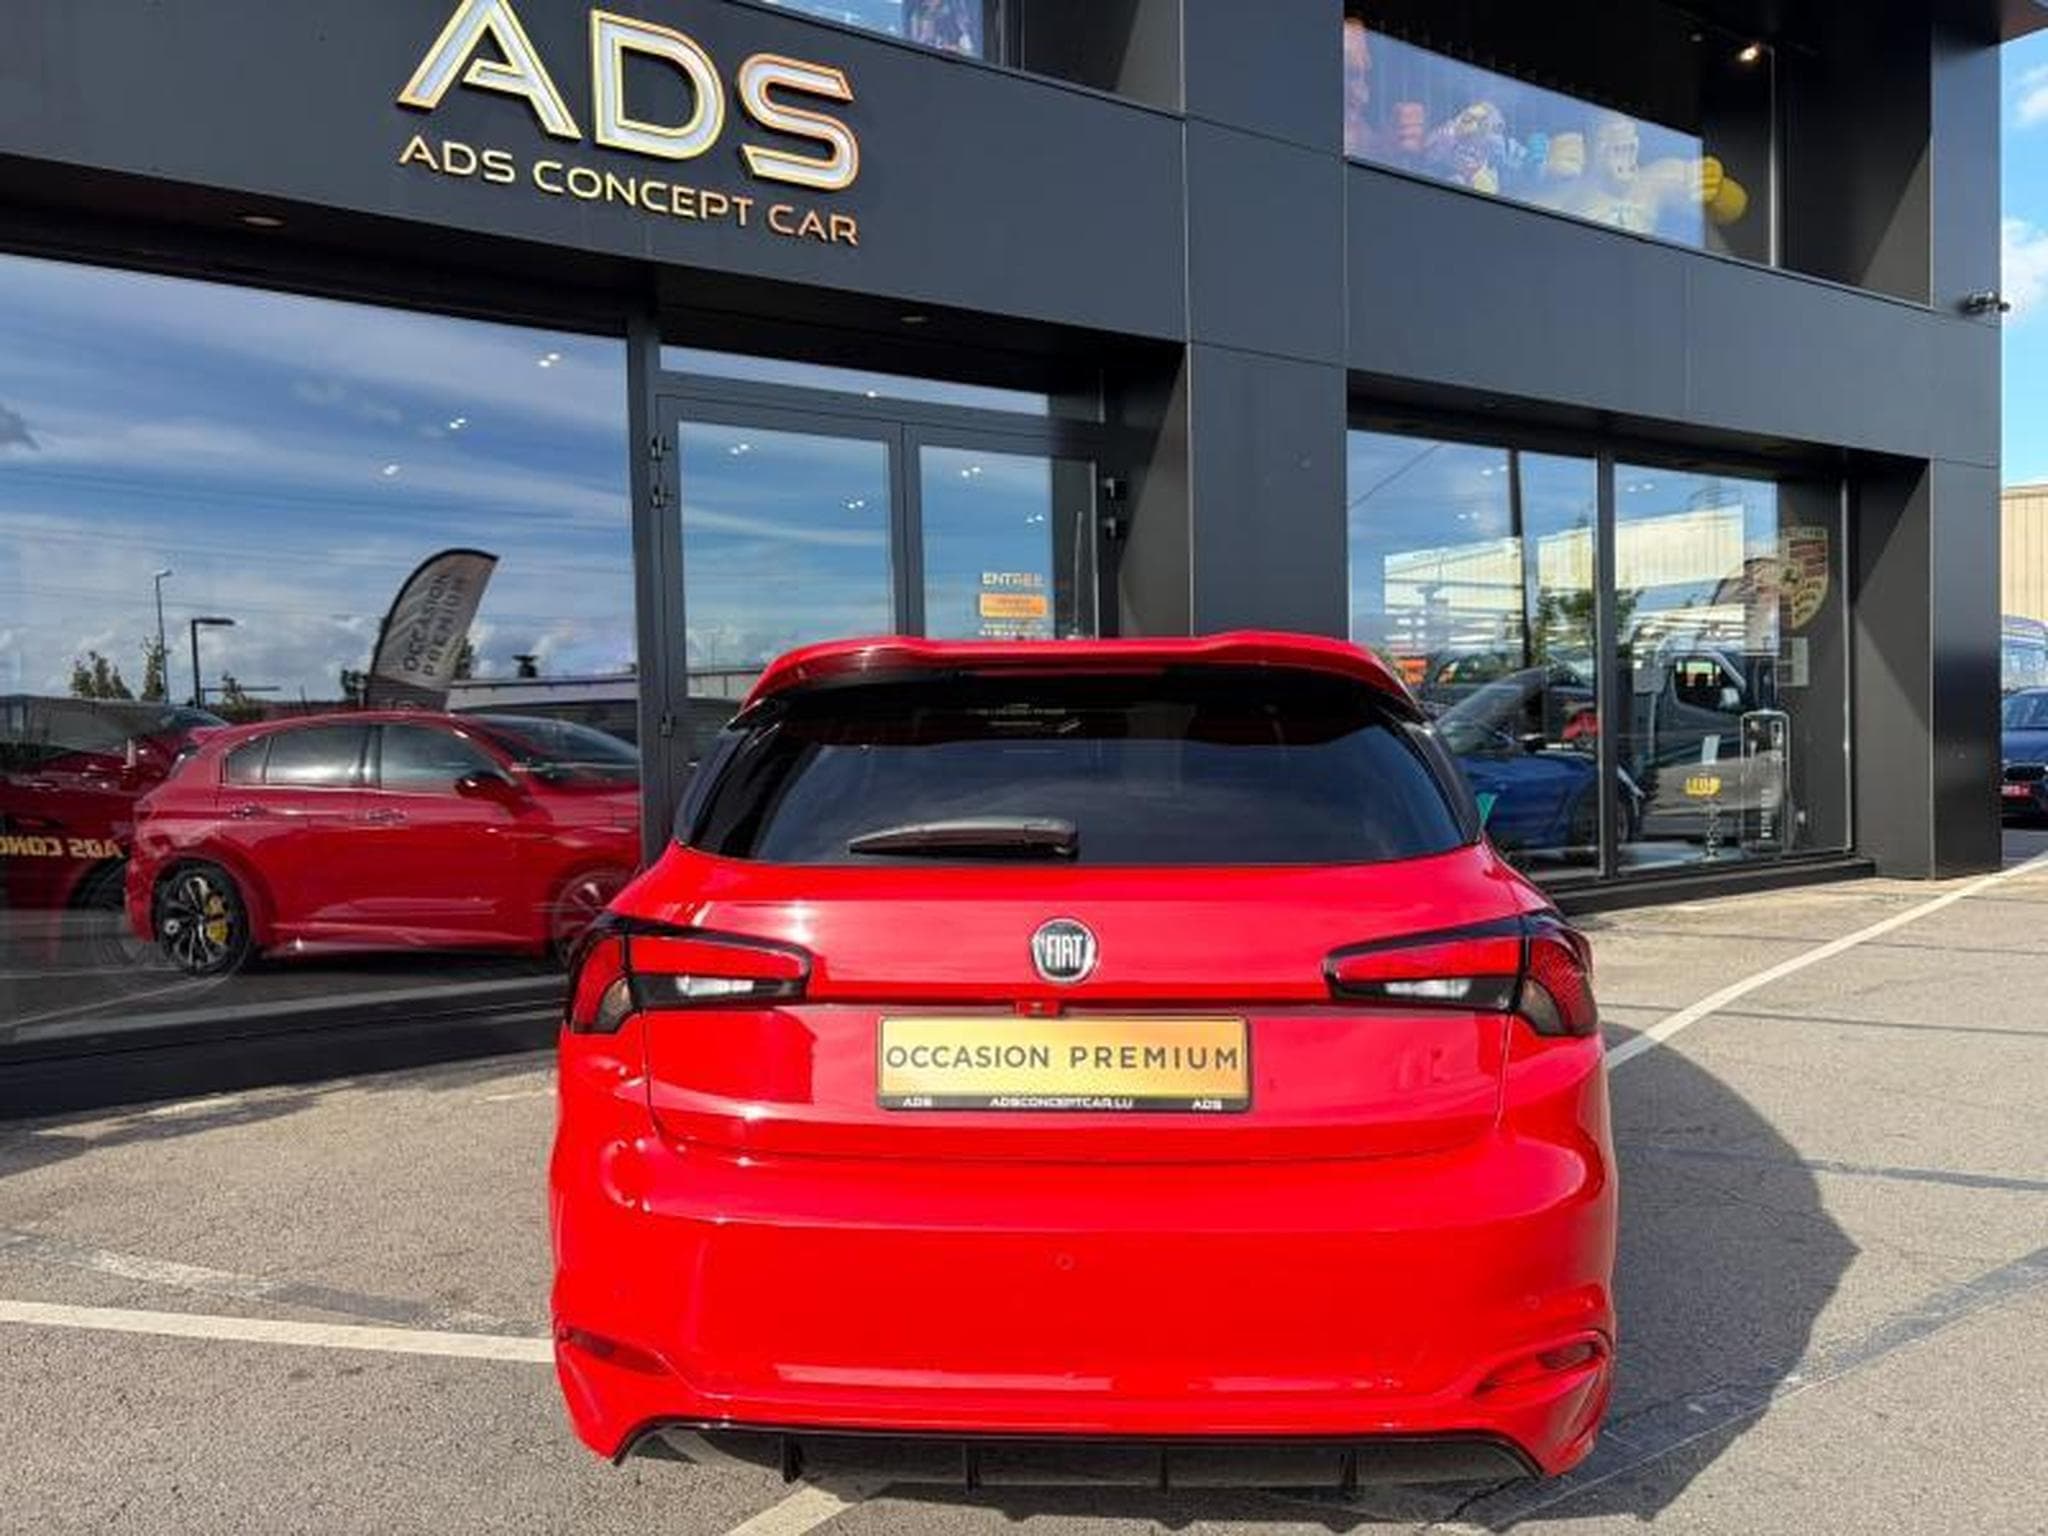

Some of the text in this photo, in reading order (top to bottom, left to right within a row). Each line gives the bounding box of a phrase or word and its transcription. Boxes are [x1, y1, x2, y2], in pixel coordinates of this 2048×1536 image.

[396, 0, 860, 192] ADS
[399, 134, 860, 247] ADS CONCEPT CAR
[1045, 933, 1084, 969] FIAT
[885, 1045, 1239, 1070] OCCASION PREMIUM
[902, 1096, 933, 1108] ADS
[1191, 1098, 1223, 1111] ADS
